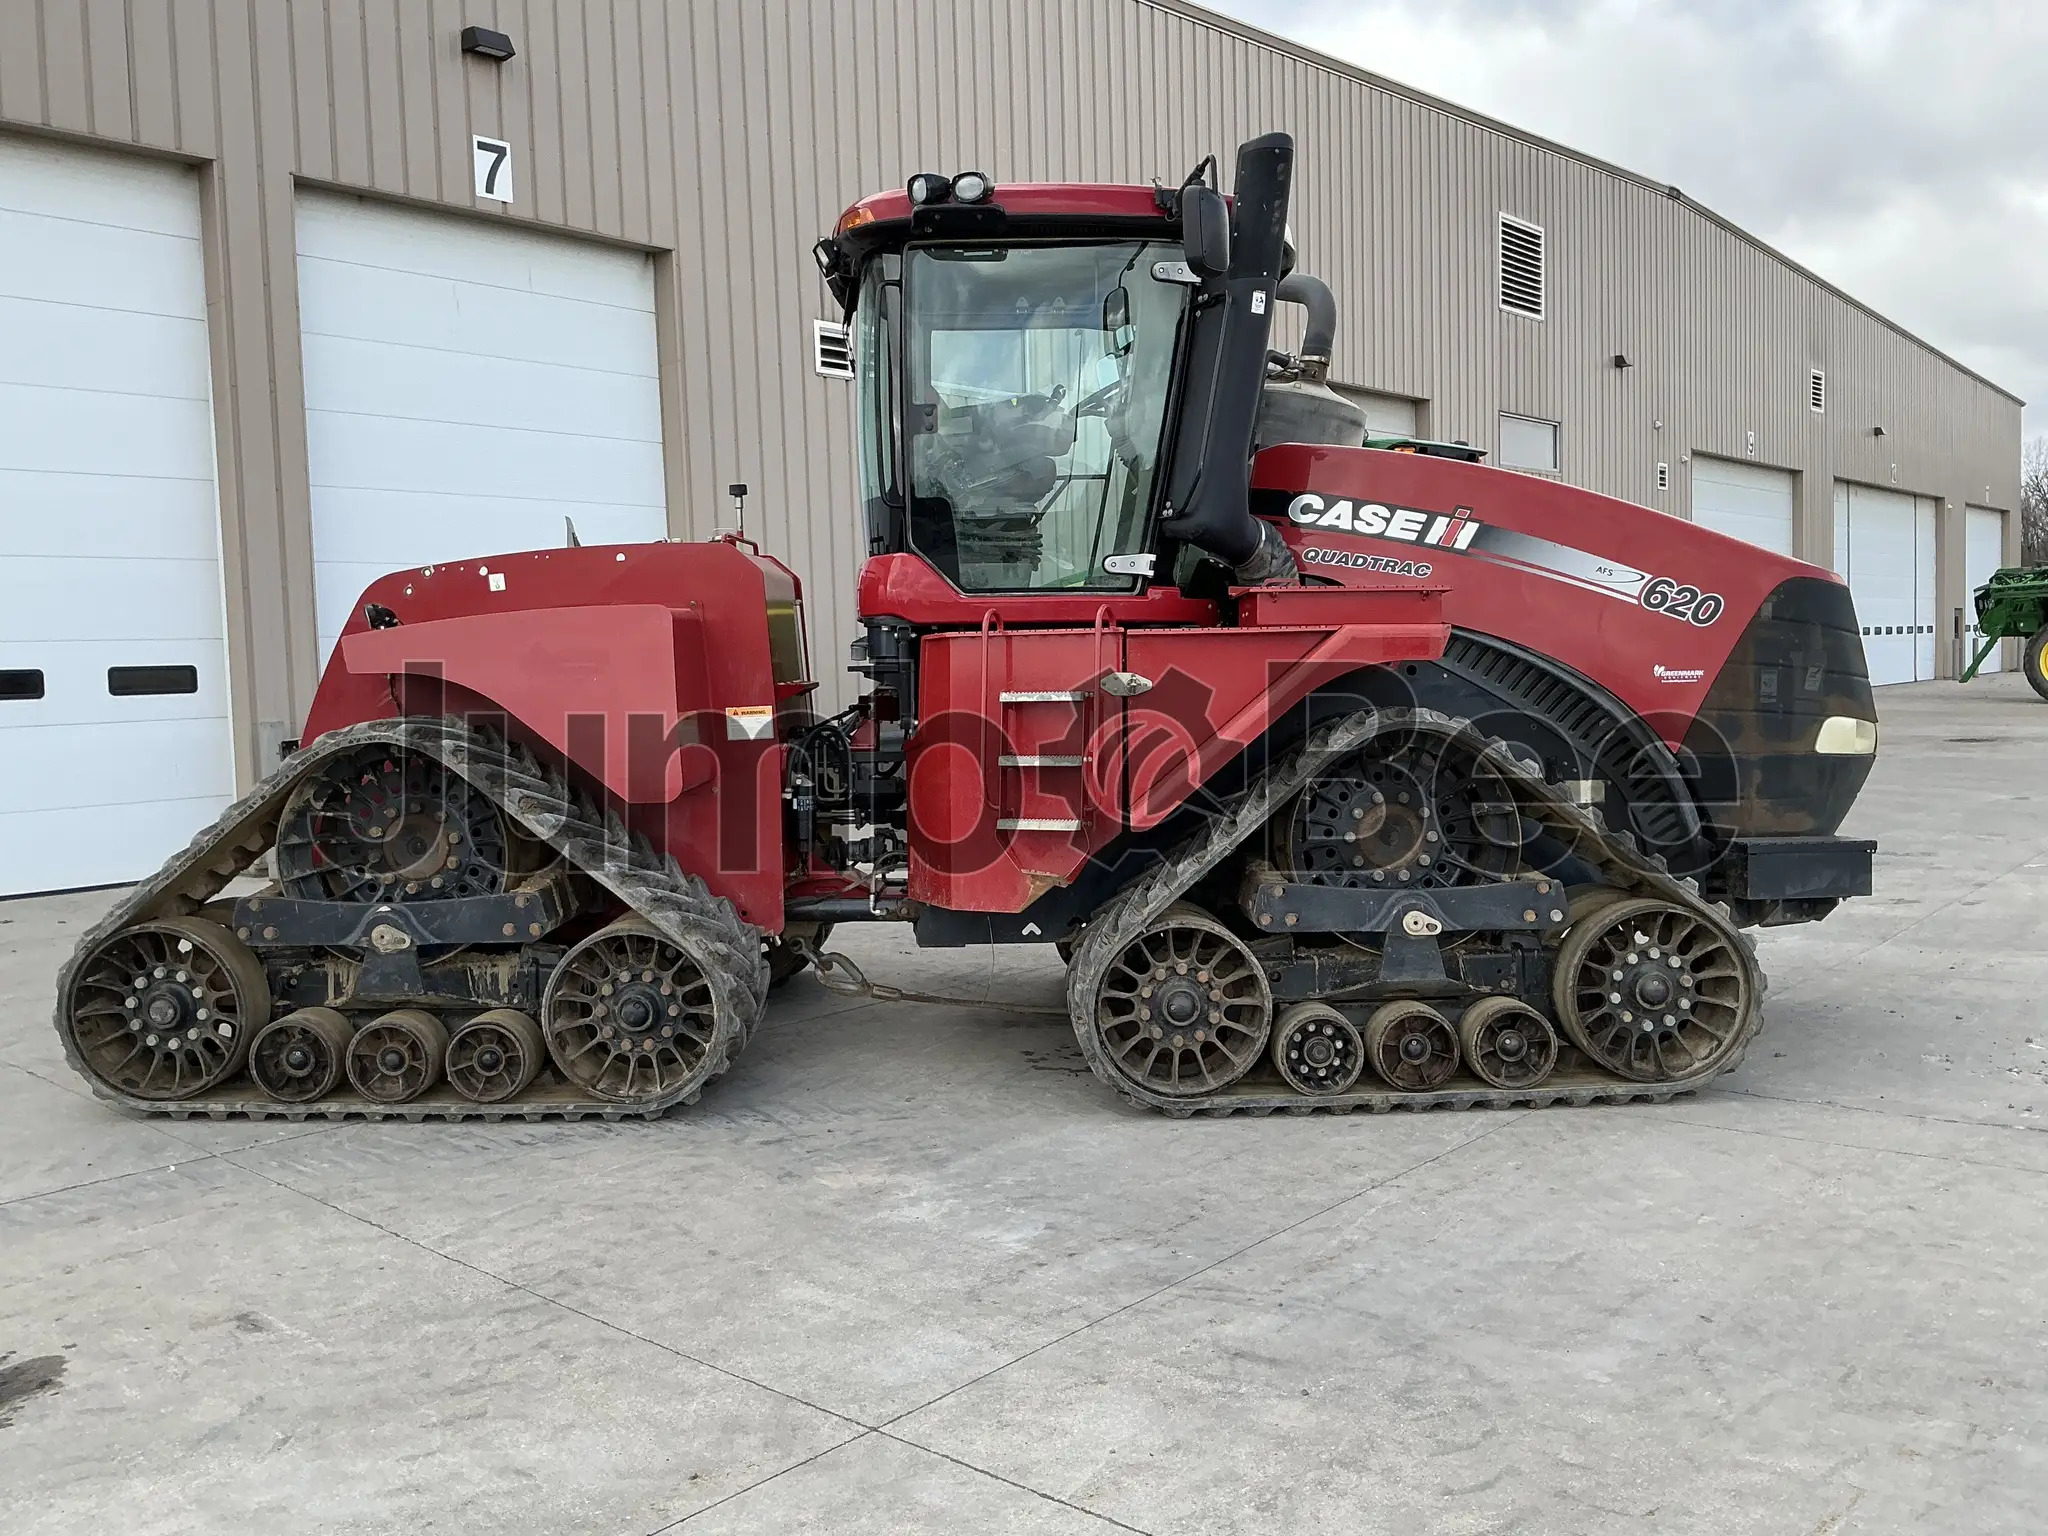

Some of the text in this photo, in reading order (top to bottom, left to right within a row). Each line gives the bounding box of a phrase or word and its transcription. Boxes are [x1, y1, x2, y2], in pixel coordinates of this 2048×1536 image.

[477, 141, 507, 195] 7
[1288, 493, 1428, 541] CASE
[1302, 547, 1433, 578] QUADTRAC
[1595, 566, 1614, 577] AFS
[1641, 577, 1725, 627] 620
